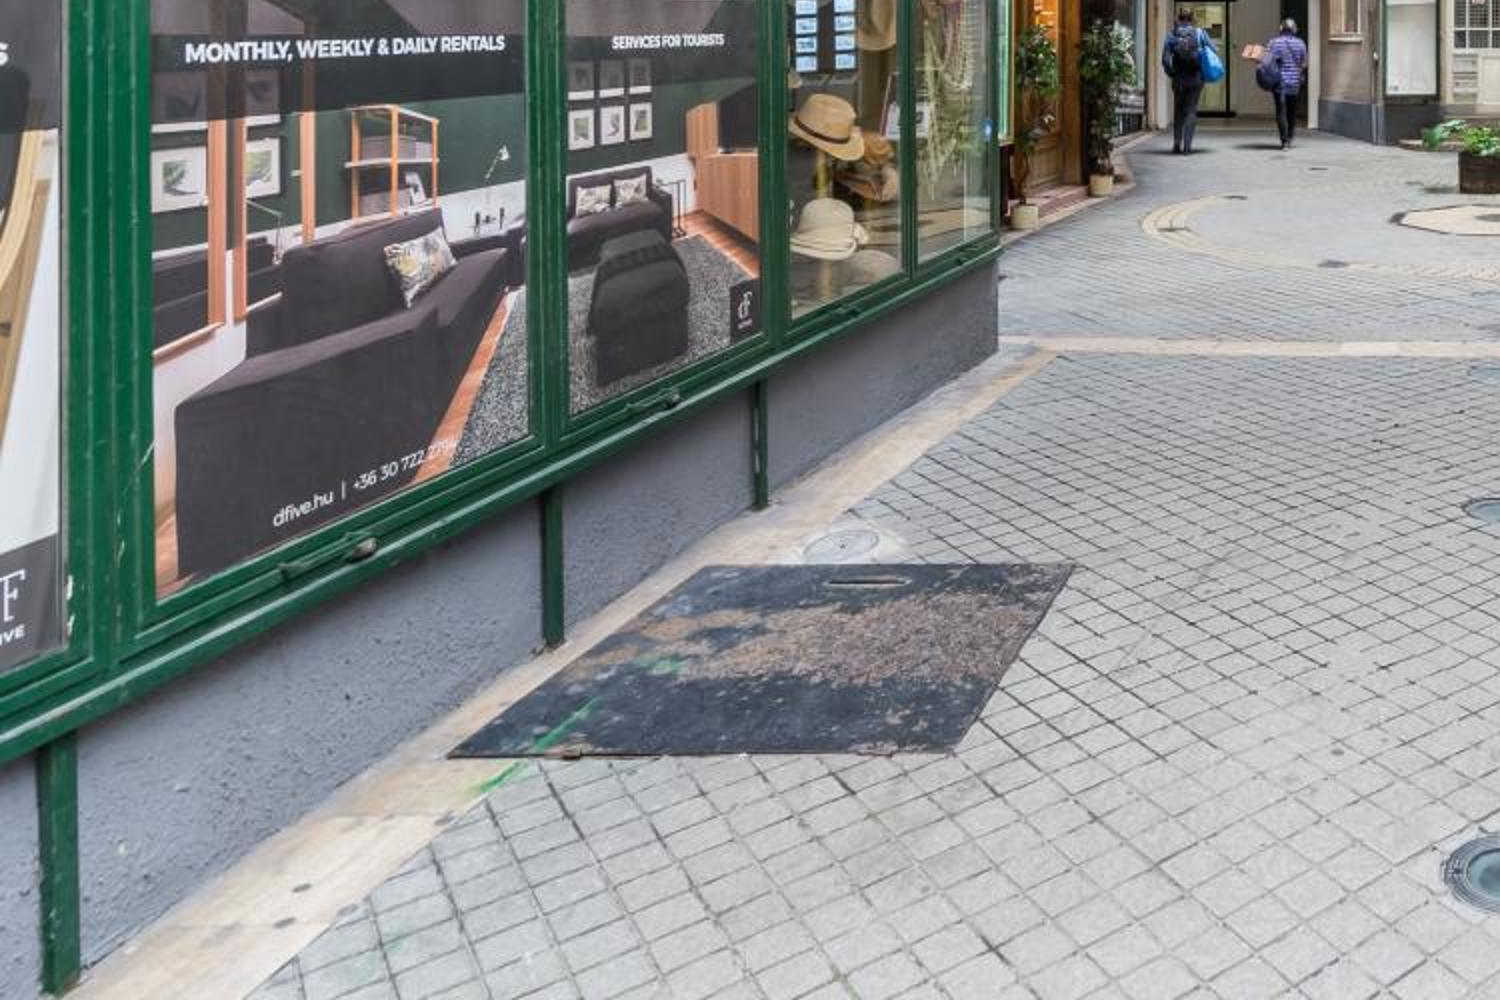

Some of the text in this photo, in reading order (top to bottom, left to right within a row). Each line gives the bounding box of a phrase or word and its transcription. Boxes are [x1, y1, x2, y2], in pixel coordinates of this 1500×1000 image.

[185, 34, 506, 64] MONTHLY, WEEKLY & DAILY RENTALS
[611, 33, 725, 50] SERVICES FOR TOURISTS
[273, 490, 334, 527] dfive.hu
[353, 470, 377, 490] +36
[379, 461, 399, 481] 30
